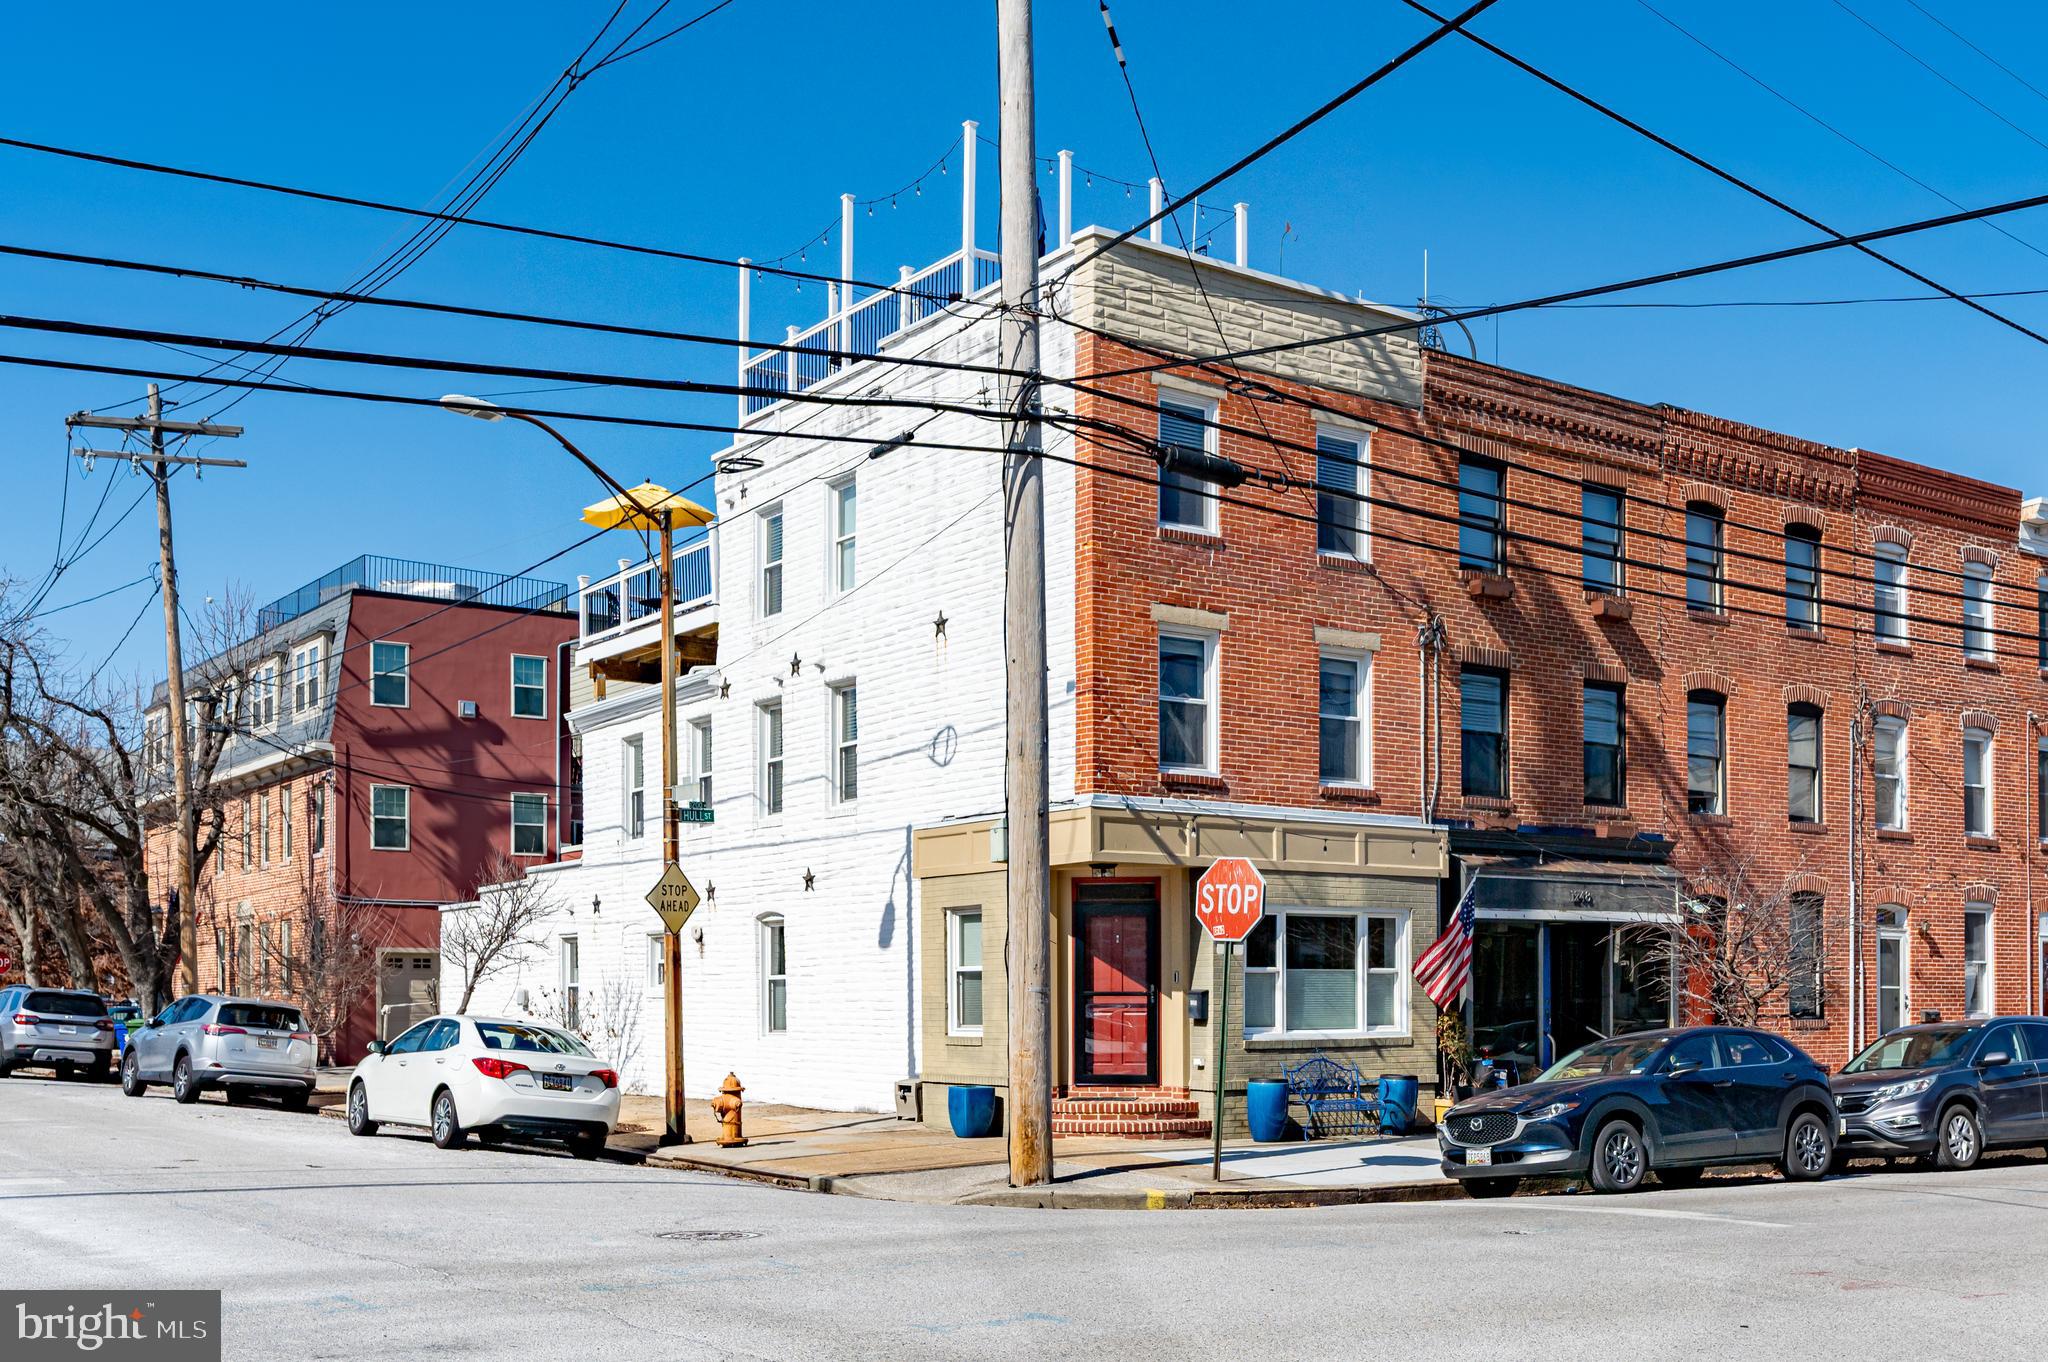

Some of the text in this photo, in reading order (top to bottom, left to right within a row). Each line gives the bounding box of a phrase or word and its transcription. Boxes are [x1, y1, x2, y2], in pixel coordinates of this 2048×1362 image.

[683, 810, 704, 821] HULL
[661, 884, 688, 897] STOP
[660, 899, 690, 912] AHEAD
[1201, 883, 1258, 915] STOP
